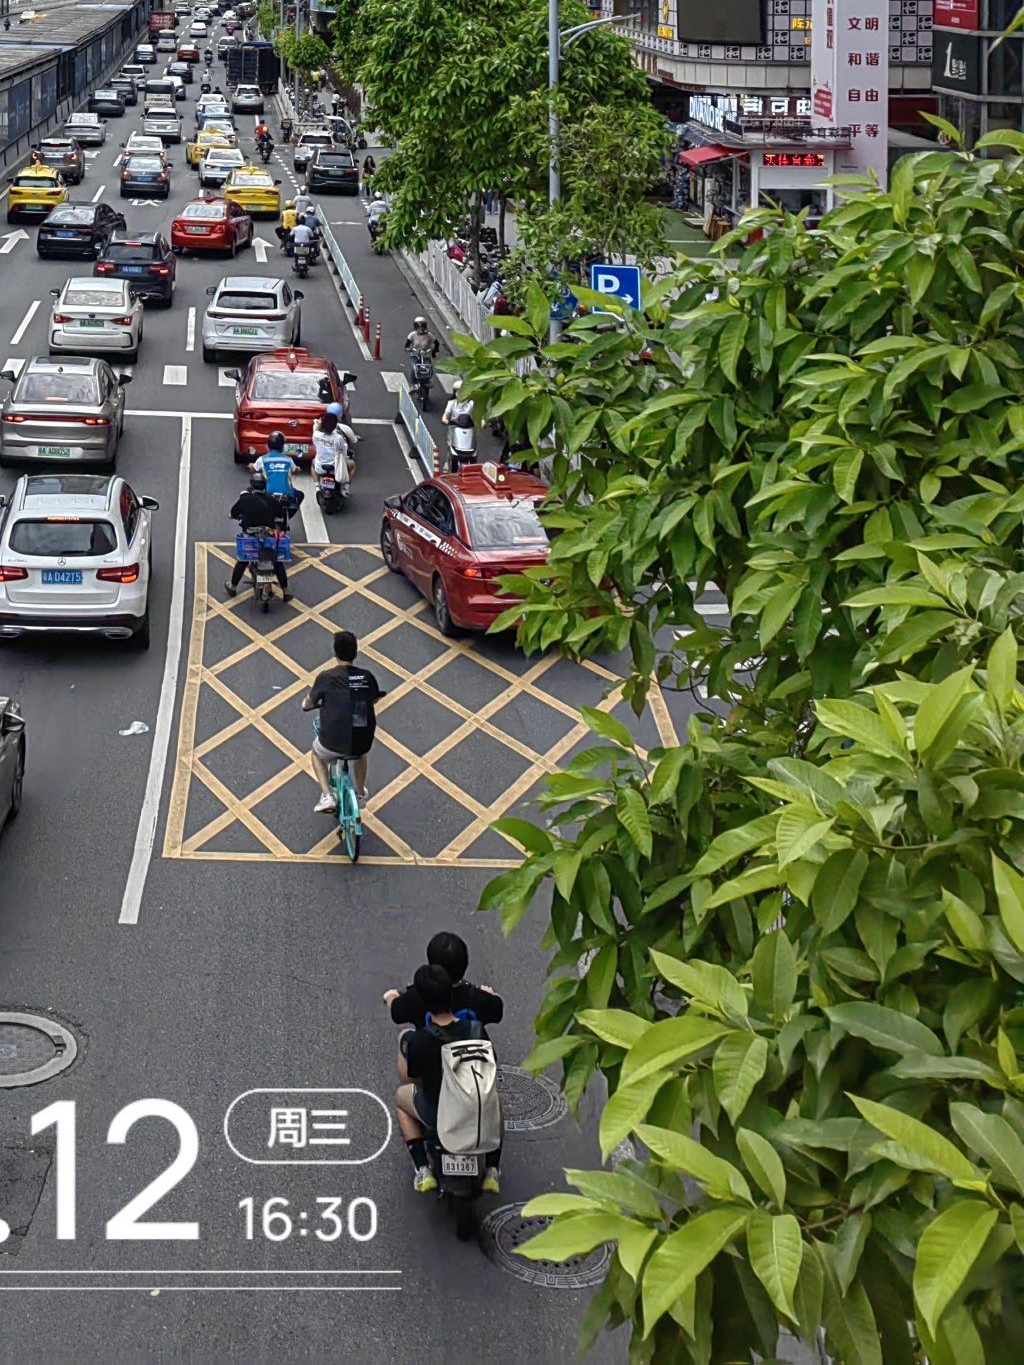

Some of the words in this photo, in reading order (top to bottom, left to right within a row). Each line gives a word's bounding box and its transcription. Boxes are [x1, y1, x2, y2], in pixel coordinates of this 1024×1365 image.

[847, 17, 879, 31] 文明
[848, 52, 880, 67] 和谐
[848, 88, 880, 103] 自由
[848, 123, 880, 139] 平等
[597, 273, 620, 296] P
